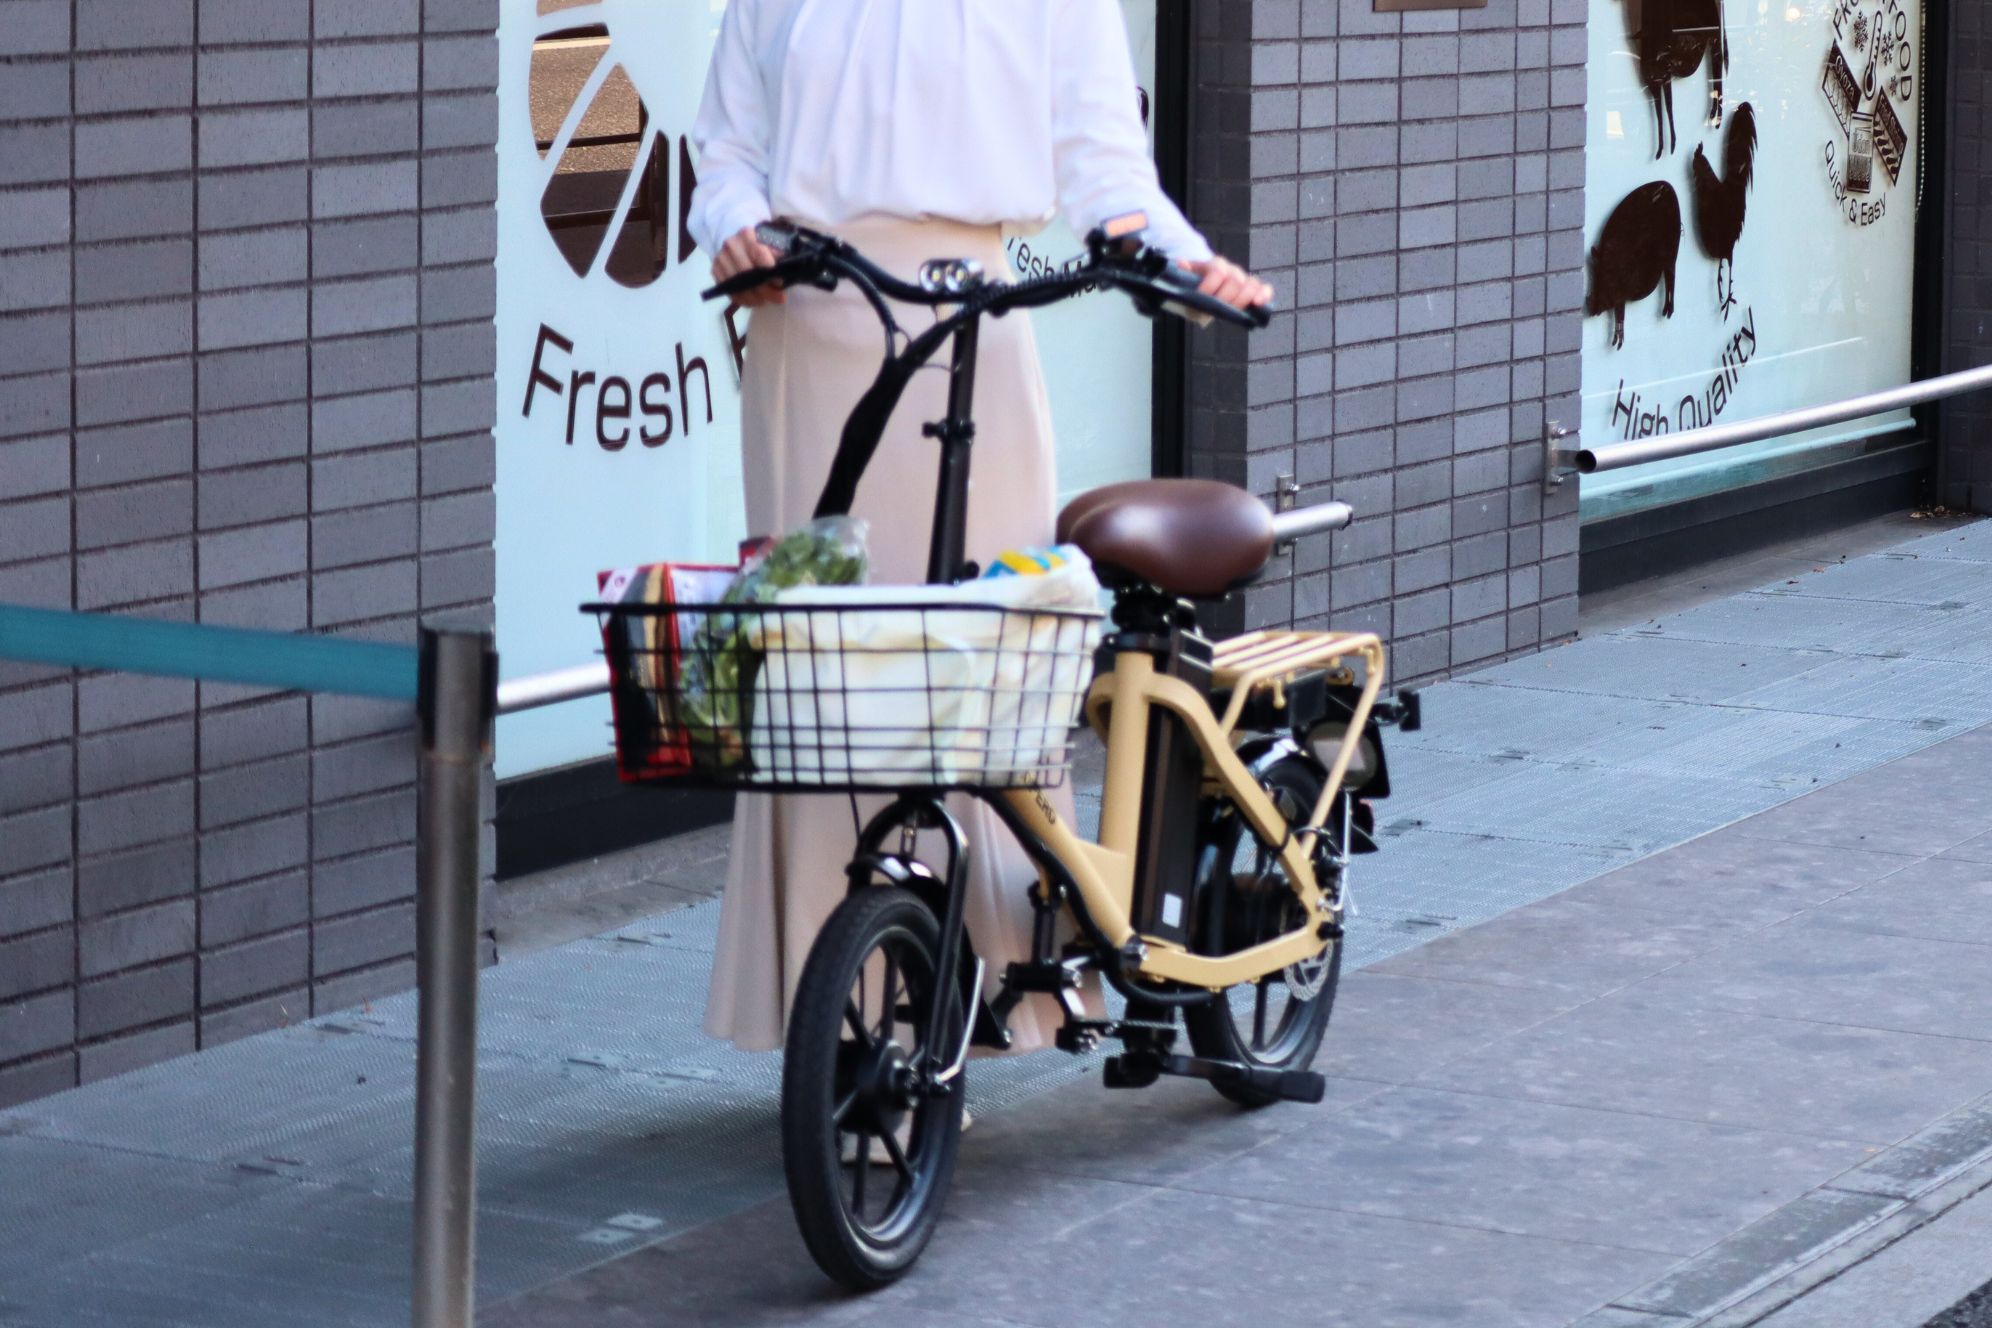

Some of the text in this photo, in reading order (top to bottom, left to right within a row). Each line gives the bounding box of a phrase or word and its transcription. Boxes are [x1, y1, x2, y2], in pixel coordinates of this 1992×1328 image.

[1825, 140, 1848, 211] Quick
[1850, 198, 1857, 225] &
[1860, 193, 1887, 226] Easy
[521, 322, 713, 452] Fresh
[1612, 304, 1756, 440] High Quality
